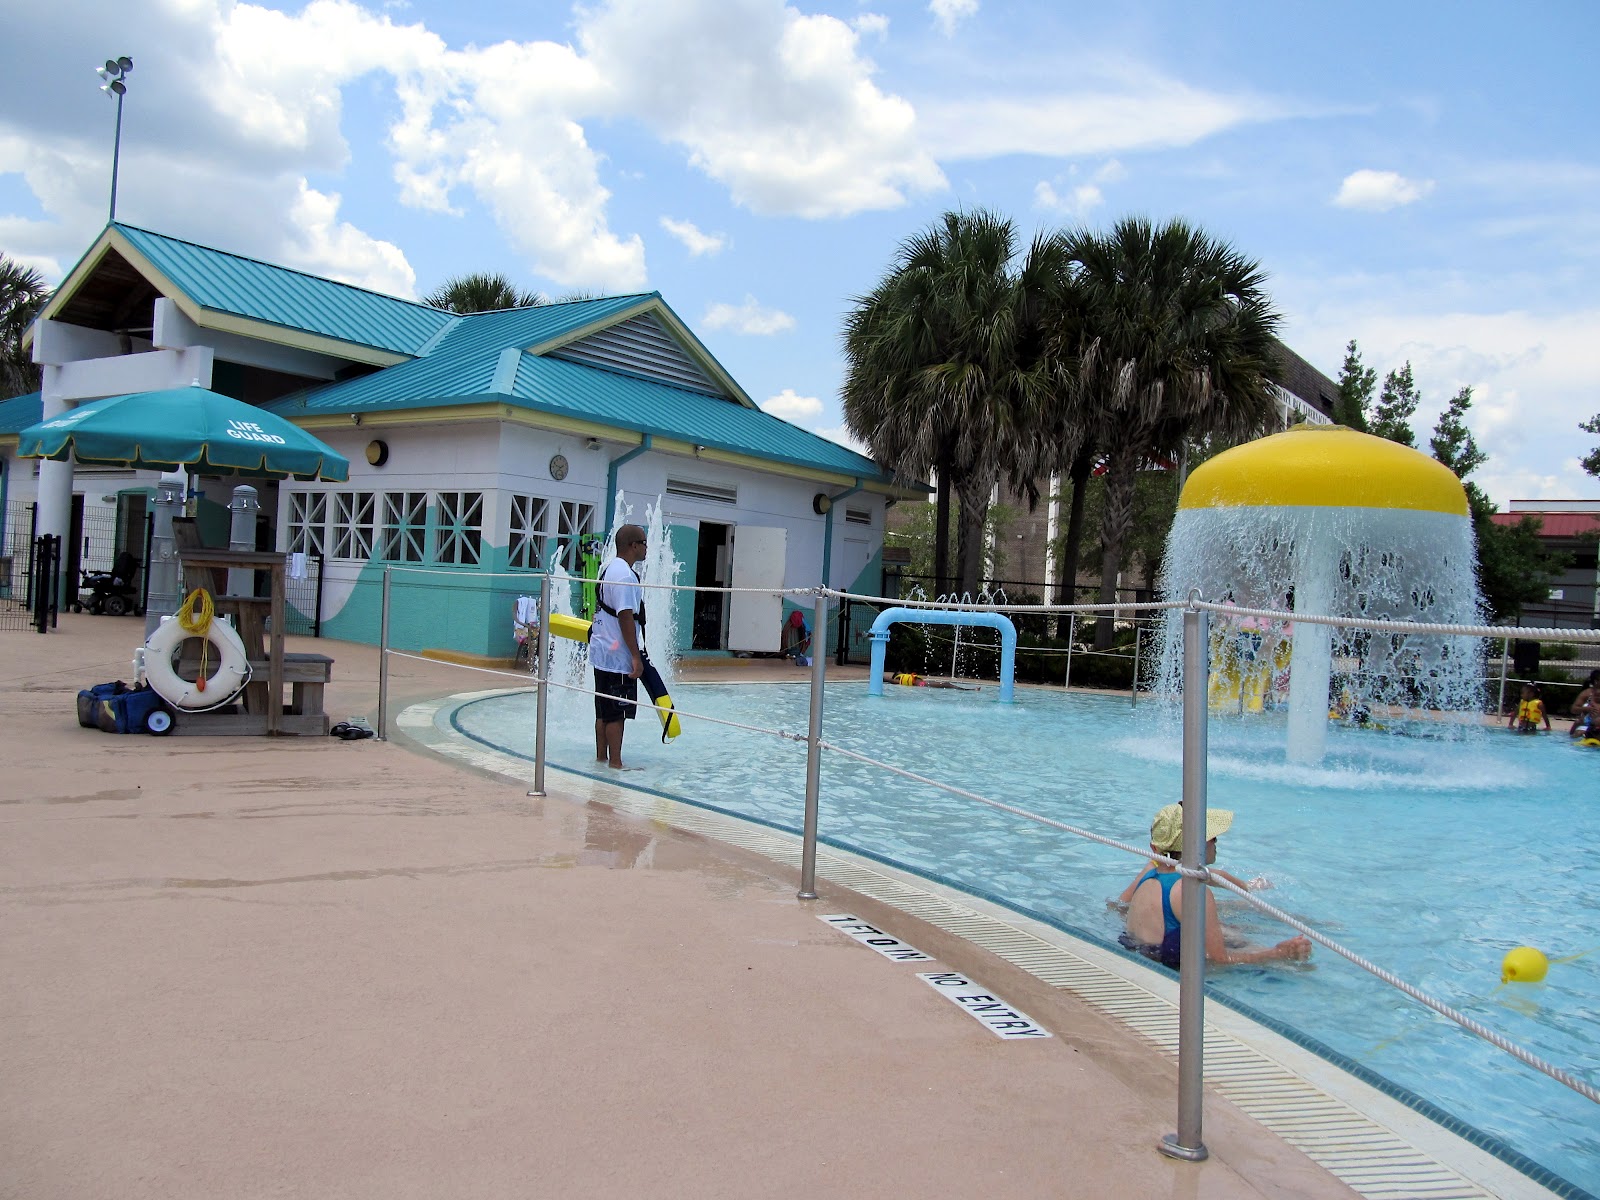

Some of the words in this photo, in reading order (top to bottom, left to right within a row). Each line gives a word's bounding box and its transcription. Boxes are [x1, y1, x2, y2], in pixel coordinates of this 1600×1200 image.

[226, 429, 286, 445] GUARD
[228, 419, 264, 433] LIFE
[841, 924, 883, 935] FT
[886, 949, 927, 960] IN
[923, 972, 968, 987] NO
[955, 995, 1046, 1039] ENTRY
